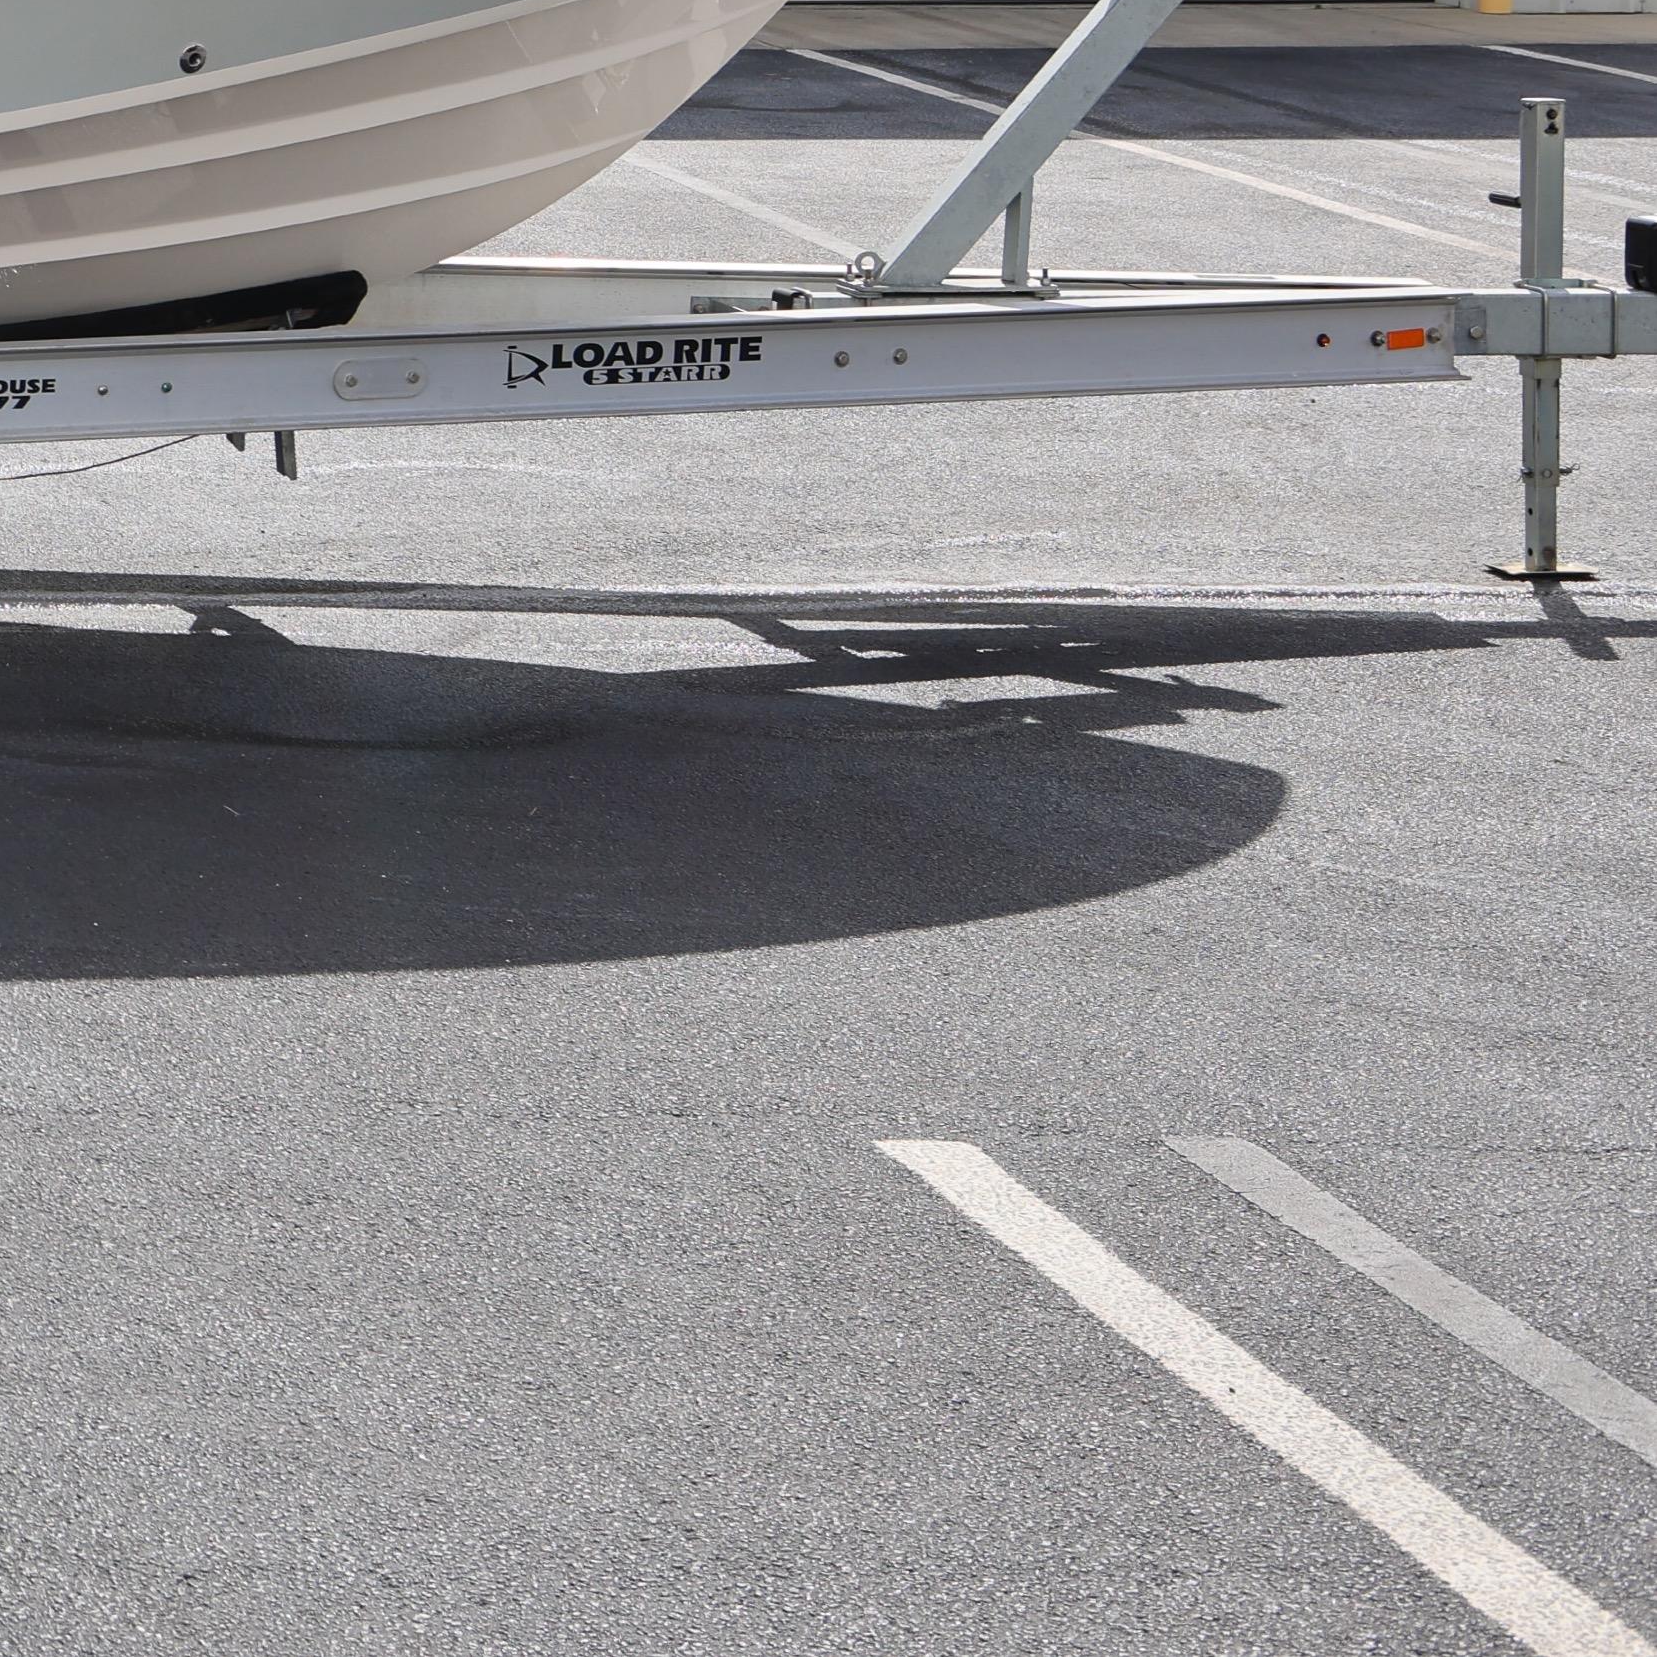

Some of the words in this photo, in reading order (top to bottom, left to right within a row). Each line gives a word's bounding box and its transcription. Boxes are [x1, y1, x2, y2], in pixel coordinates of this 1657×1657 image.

[551, 340, 663, 369] LOAD
[673, 336, 763, 364] RITE
[591, 369, 609, 384] 5
[617, 363, 723, 383] STARR
